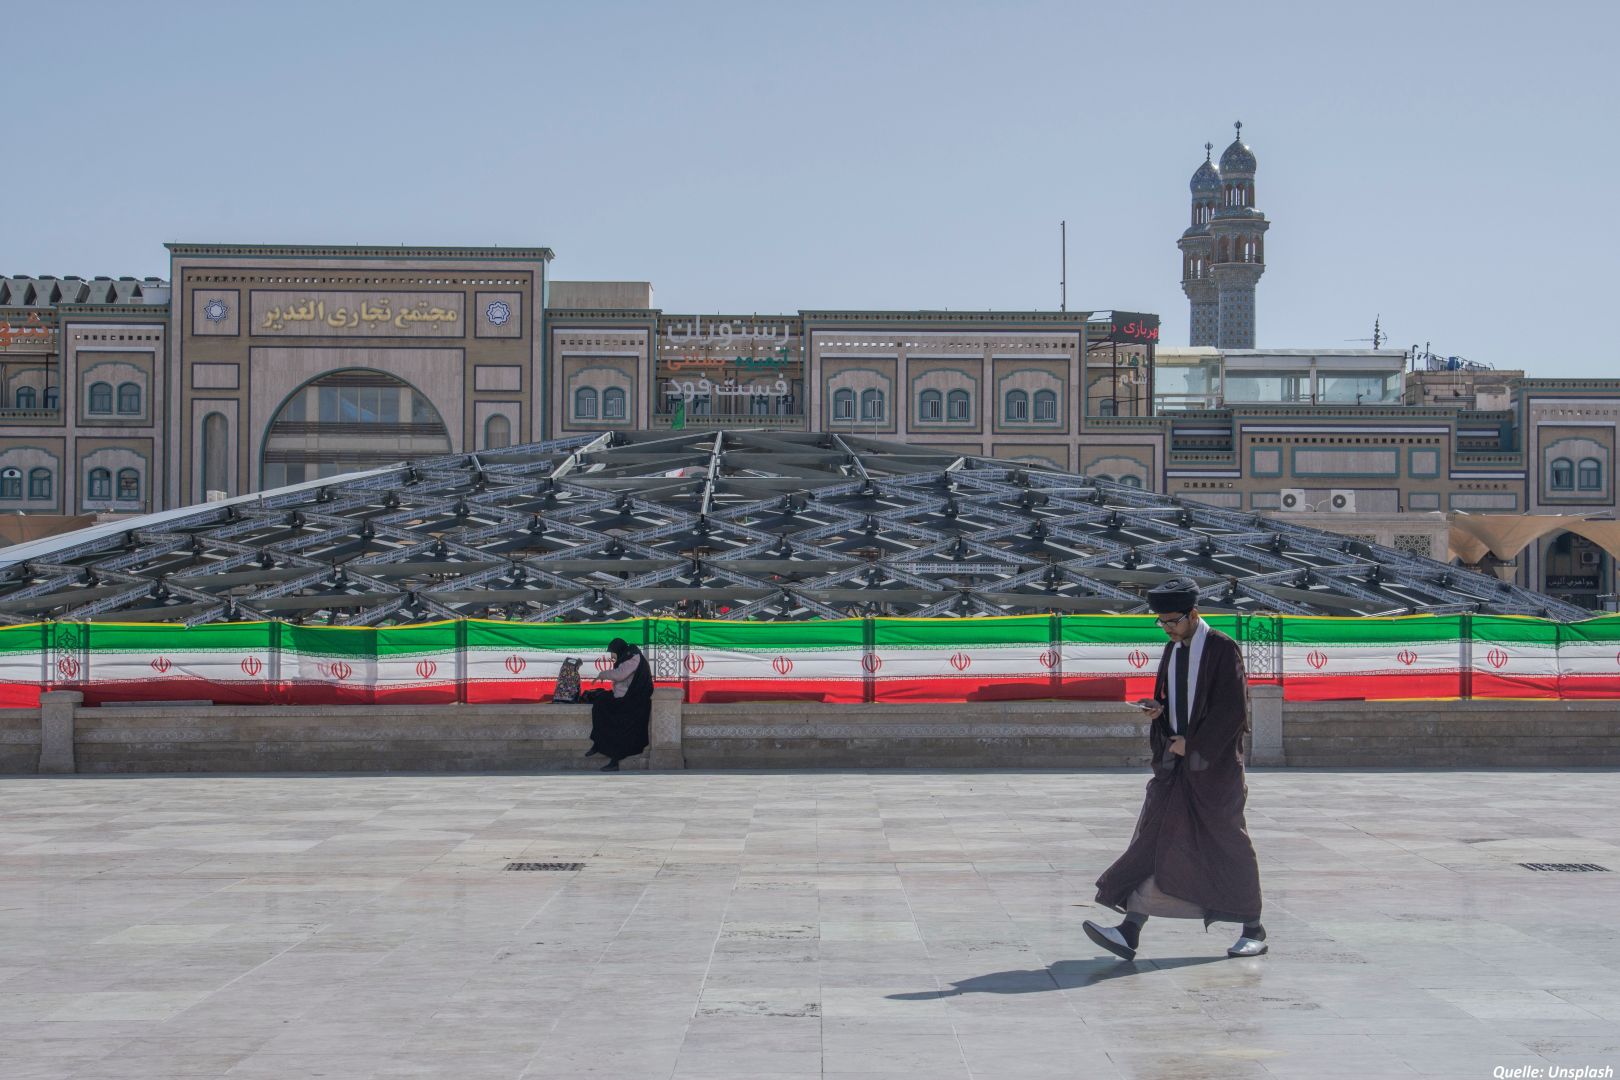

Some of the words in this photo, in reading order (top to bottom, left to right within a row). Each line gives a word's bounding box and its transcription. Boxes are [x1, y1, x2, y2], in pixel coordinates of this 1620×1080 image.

[262, 298, 324, 330] الغدیر
[327, 298, 392, 329] تجاری
[394, 301, 458, 329] مجتمع
[667, 315, 789, 347] رستوران
[664, 371, 711, 403] فود
[715, 373, 788, 396] فست
